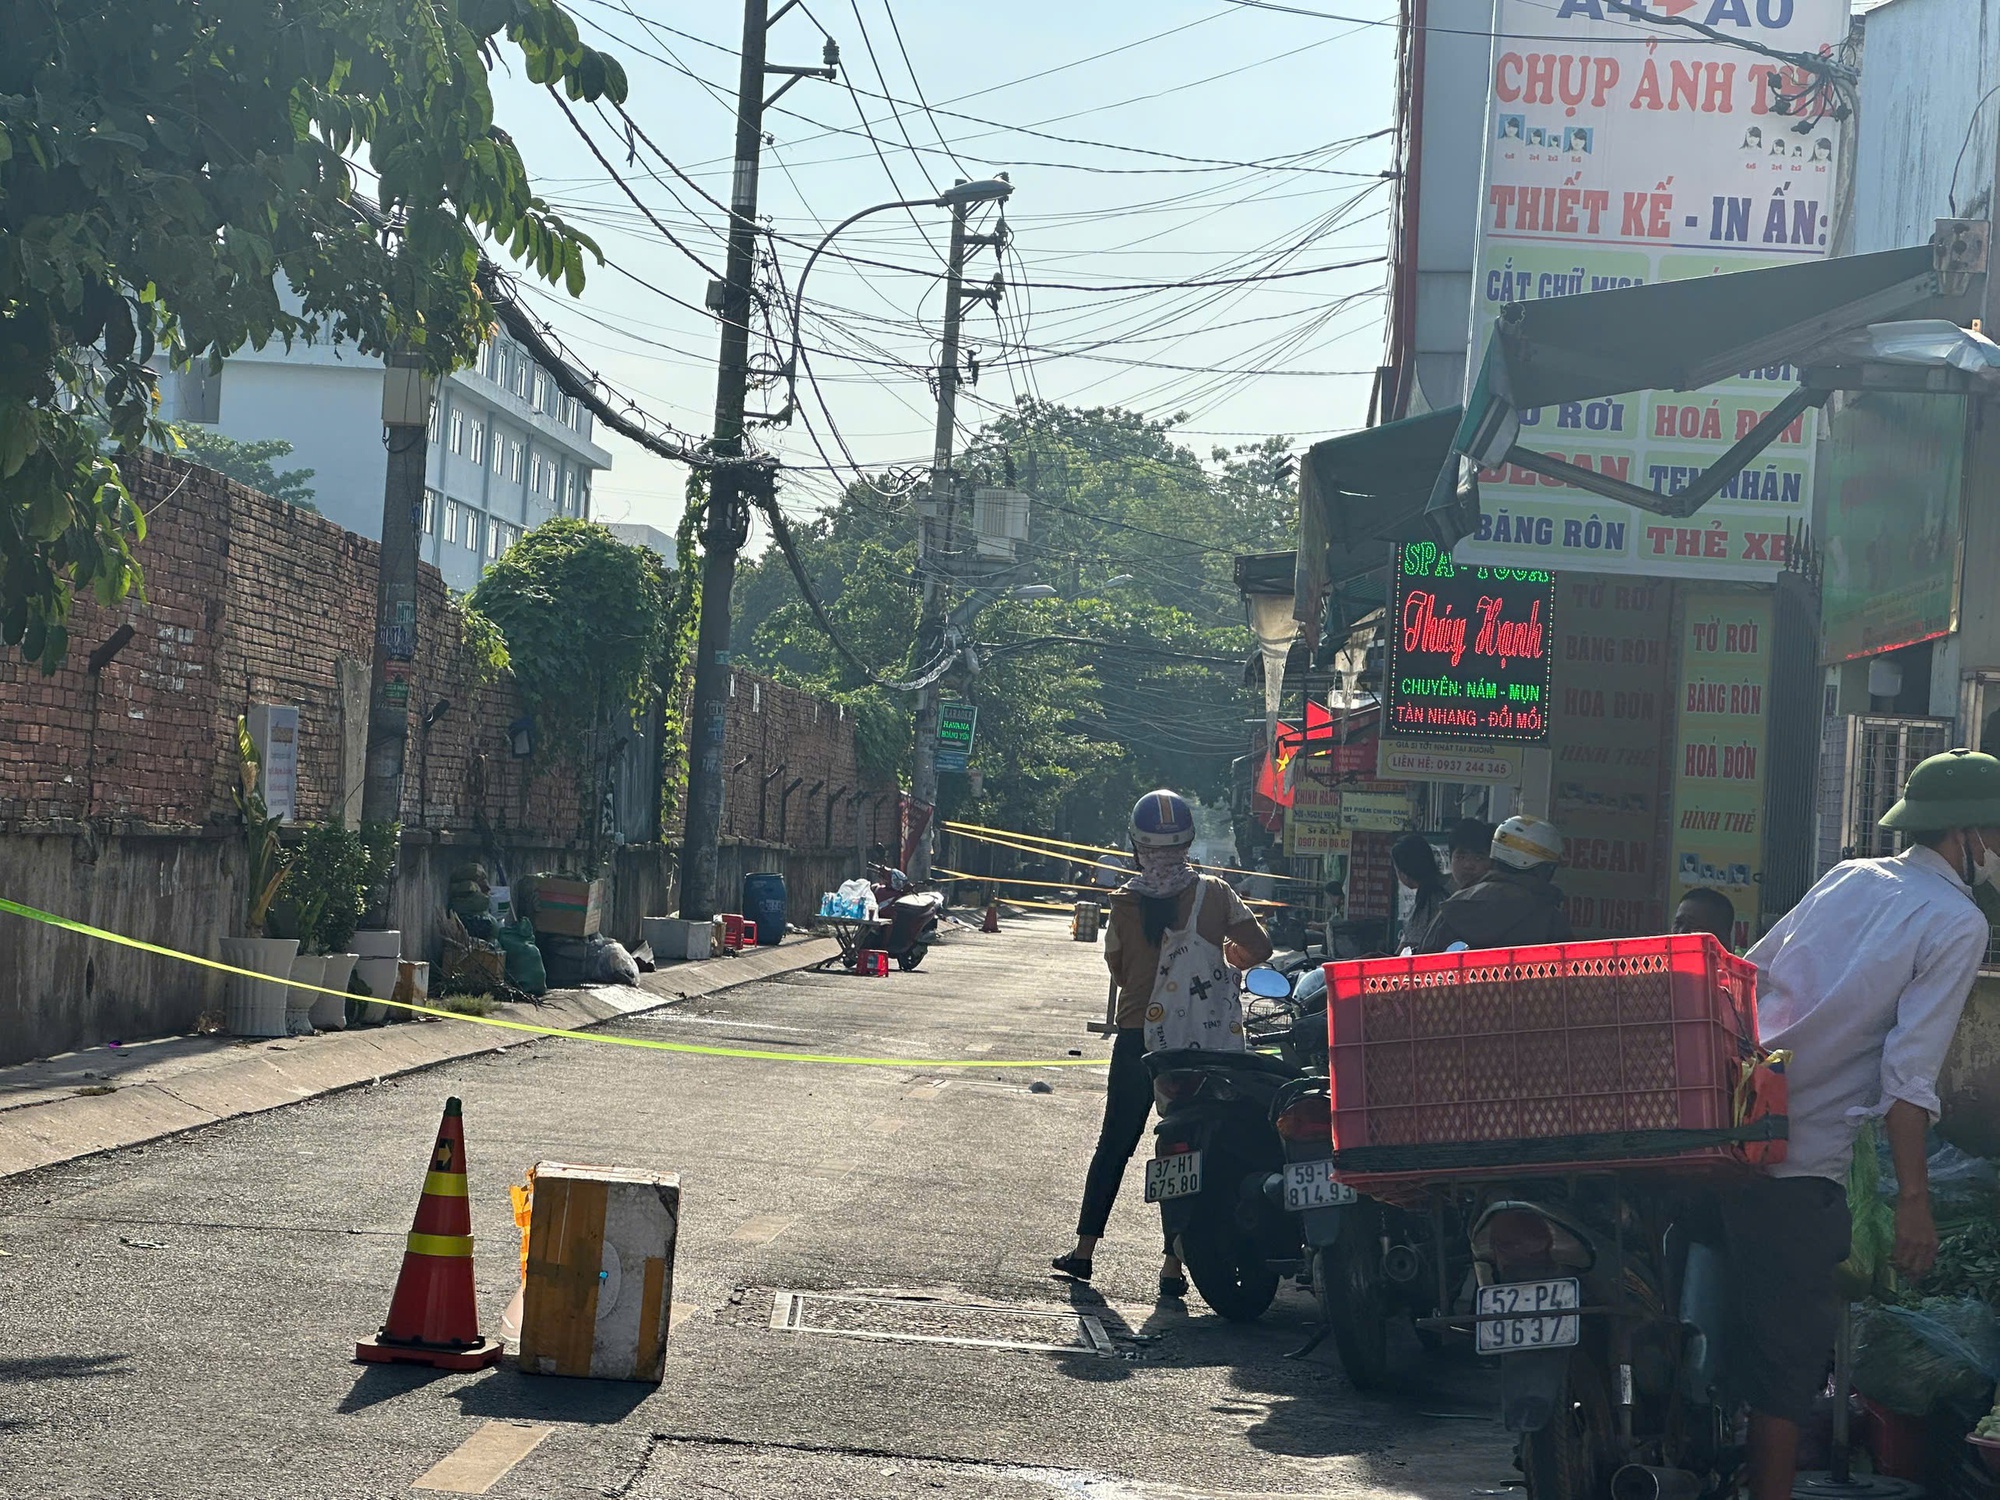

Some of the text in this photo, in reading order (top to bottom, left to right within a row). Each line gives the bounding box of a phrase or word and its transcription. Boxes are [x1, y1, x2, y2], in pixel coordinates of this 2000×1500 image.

[1496, 52, 1619, 117] CHỤP
[1630, 35, 1736, 115] ẢNH
[1489, 171, 1608, 234] THIẾT
[1620, 176, 1674, 239] KẾ
[1710, 196, 1752, 242] IN
[1762, 181, 1829, 247] ẤN:
[1486, 257, 1532, 301] CẮT
[1557, 398, 1625, 431] RƠI
[1655, 399, 1722, 440] HOÁ
[1473, 509, 1626, 551] BĂNG RÔN
[1646, 520, 1728, 558] THẺ
[1692, 615, 1759, 654] TỜ RƠI
[1401, 675, 1463, 697] CHUYÊN:
[1466, 677, 1497, 699] NÁM
[1508, 683, 1540, 704] MỤN
[1686, 677, 1762, 716] BĂNG RÔN
[943, 721, 970, 731] HAVANA
[1427, 707, 1477, 727] NHANG
[1392, 754, 1507, 775] LIÊN HỆ: 0937 244 345
[1684, 735, 1757, 780] HOÁ ĐƠN
[1149, 1174, 1198, 1199] 675.80
[1155, 1161, 1193, 1179] 37-H1
[1289, 1183, 1352, 1206] 814.93
[1493, 1284, 1563, 1314] 52-P4
[1493, 1315, 1563, 1346] 9637
